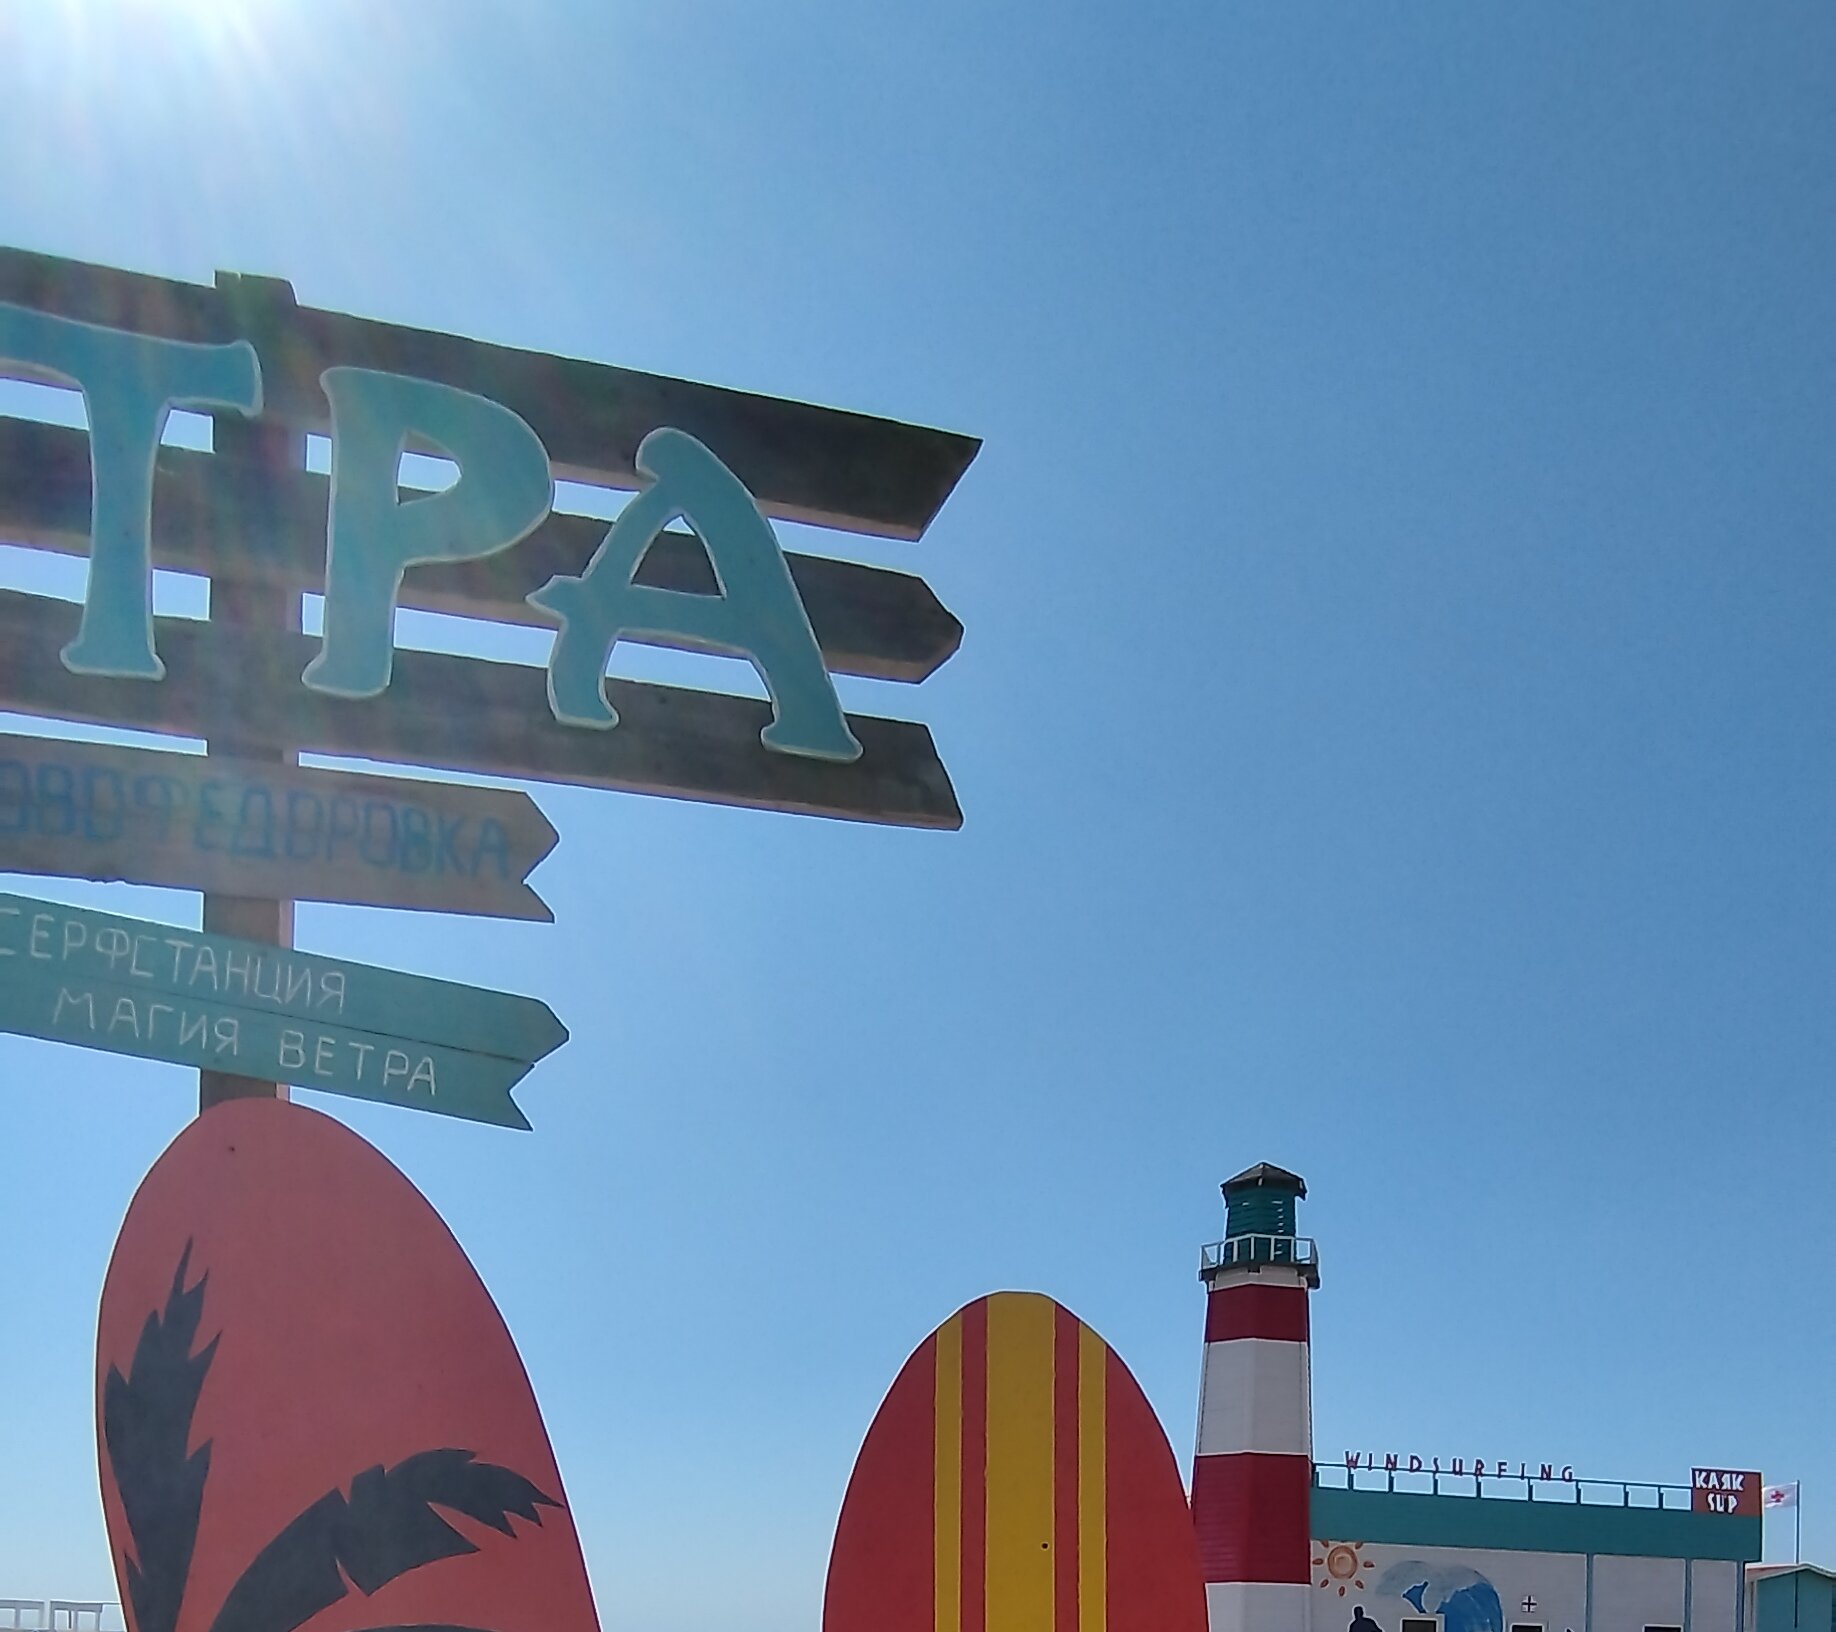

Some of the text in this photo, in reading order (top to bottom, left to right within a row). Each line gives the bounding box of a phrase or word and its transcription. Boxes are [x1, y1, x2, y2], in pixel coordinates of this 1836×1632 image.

[52, 986, 437, 1096] МАГИЯ ВЕТРА
[1345, 1450, 1573, 1482] WINDSURFING
[1694, 1470, 1745, 1491] КАЯК
[1707, 1492, 1738, 1514] SUP
